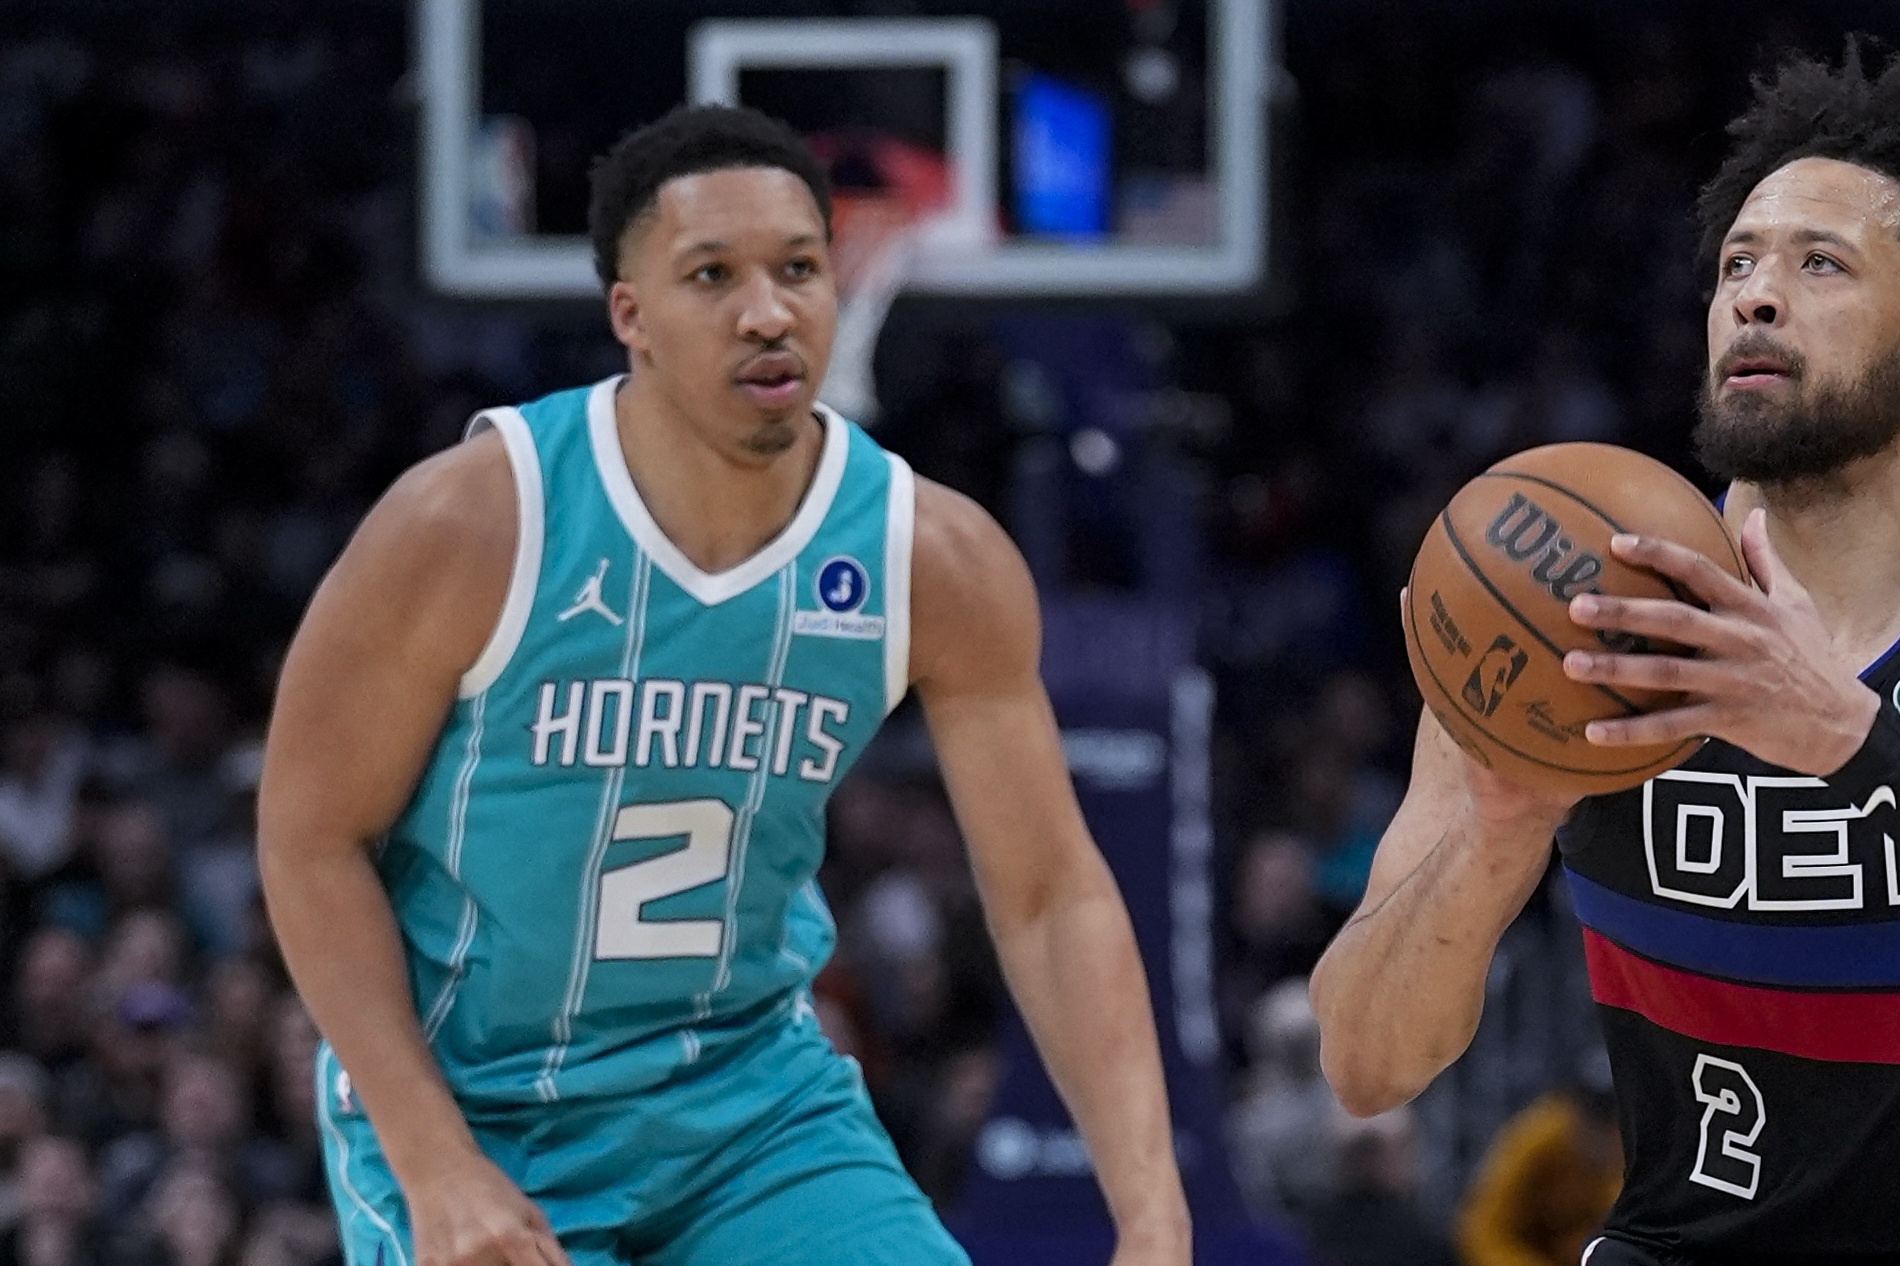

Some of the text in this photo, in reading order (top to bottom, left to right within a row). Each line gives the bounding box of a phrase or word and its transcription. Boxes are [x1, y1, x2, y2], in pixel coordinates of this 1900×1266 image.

[531, 678, 849, 782] HORNETS
[594, 798, 734, 961] 2
[1689, 1053, 1766, 1200] 2
